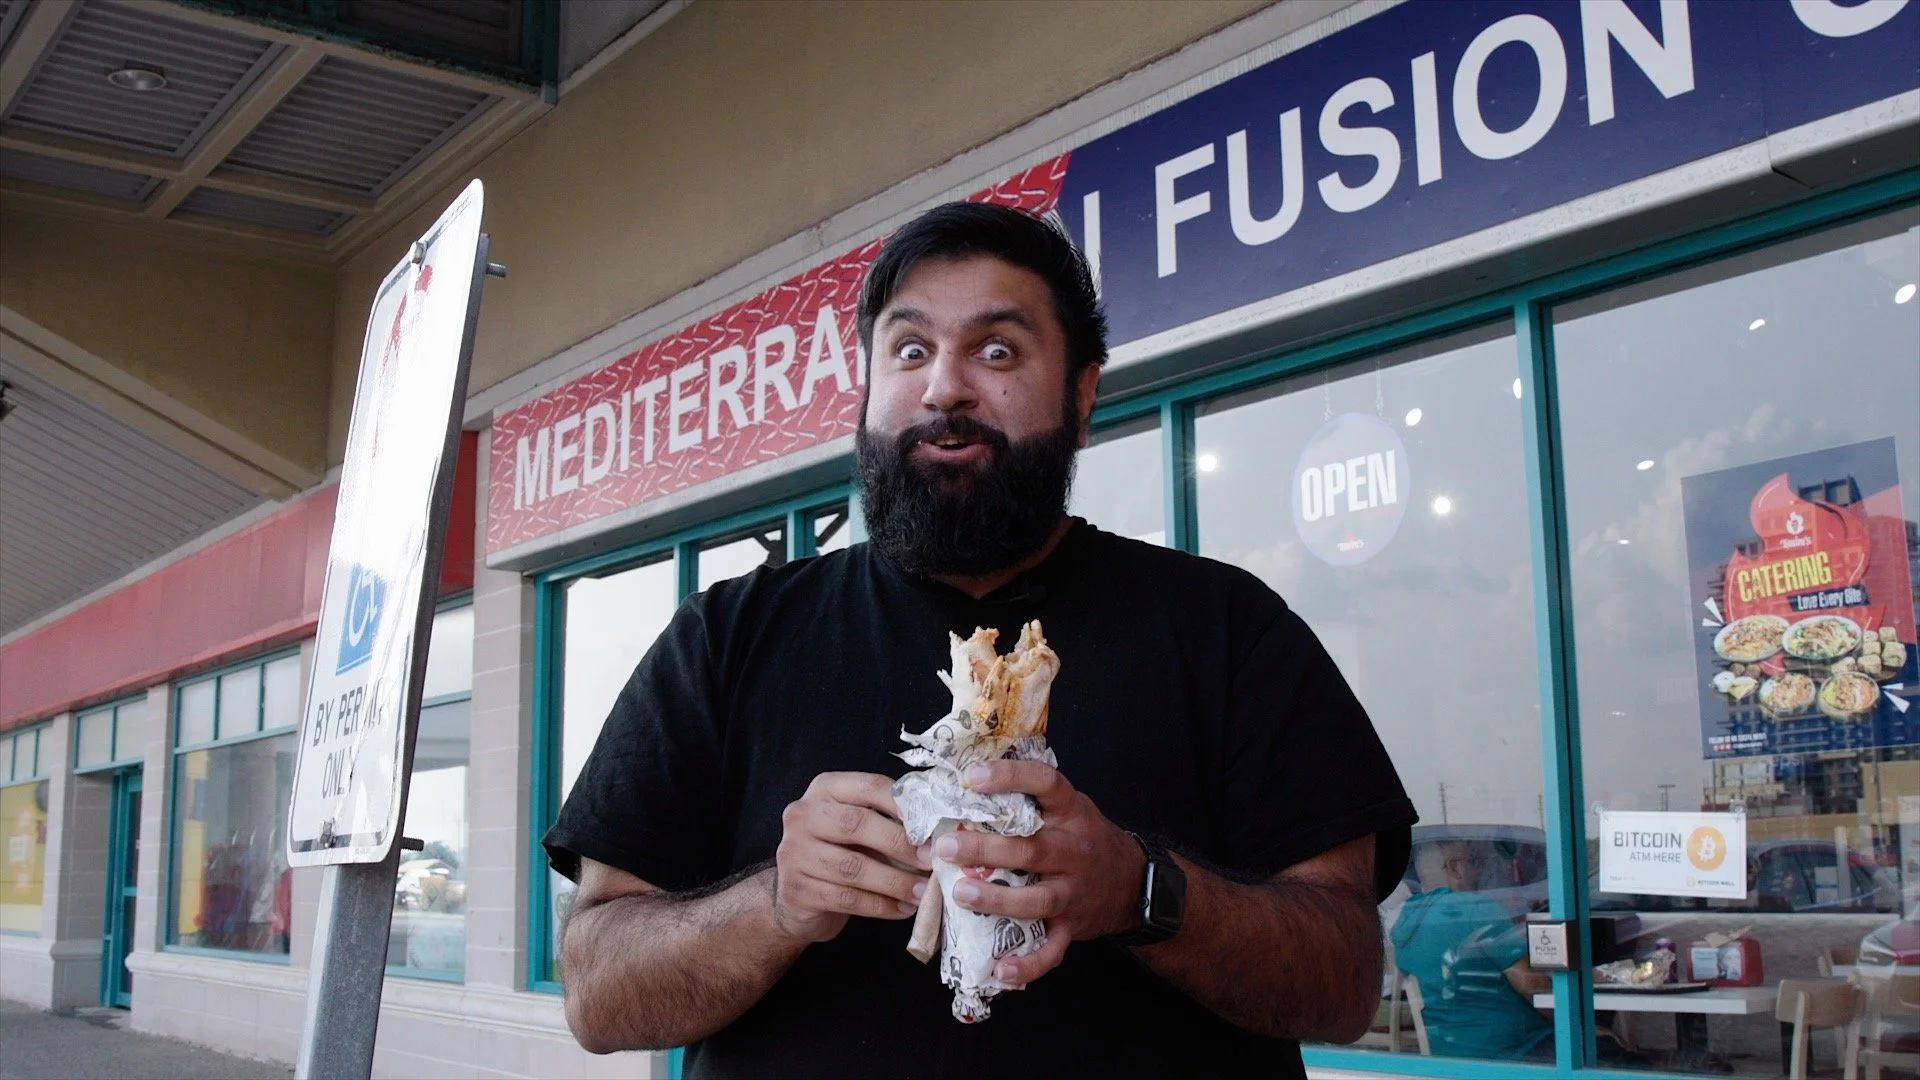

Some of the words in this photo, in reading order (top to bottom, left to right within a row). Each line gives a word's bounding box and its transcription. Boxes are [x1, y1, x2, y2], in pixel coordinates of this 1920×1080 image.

[513, 304, 867, 512] MEDITERRA
[1155, 0, 1695, 278] FUSION
[1301, 450, 1397, 522] OPEN
[1737, 551, 1832, 602] CATERING
[1797, 595, 1818, 610] Love
[1818, 591, 1844, 608] Every
[313, 698, 335, 747] BY
[1613, 831, 1682, 849] BITCOIN
[1629, 851, 1651, 862] ATM
[1653, 852, 1682, 863] HERE
